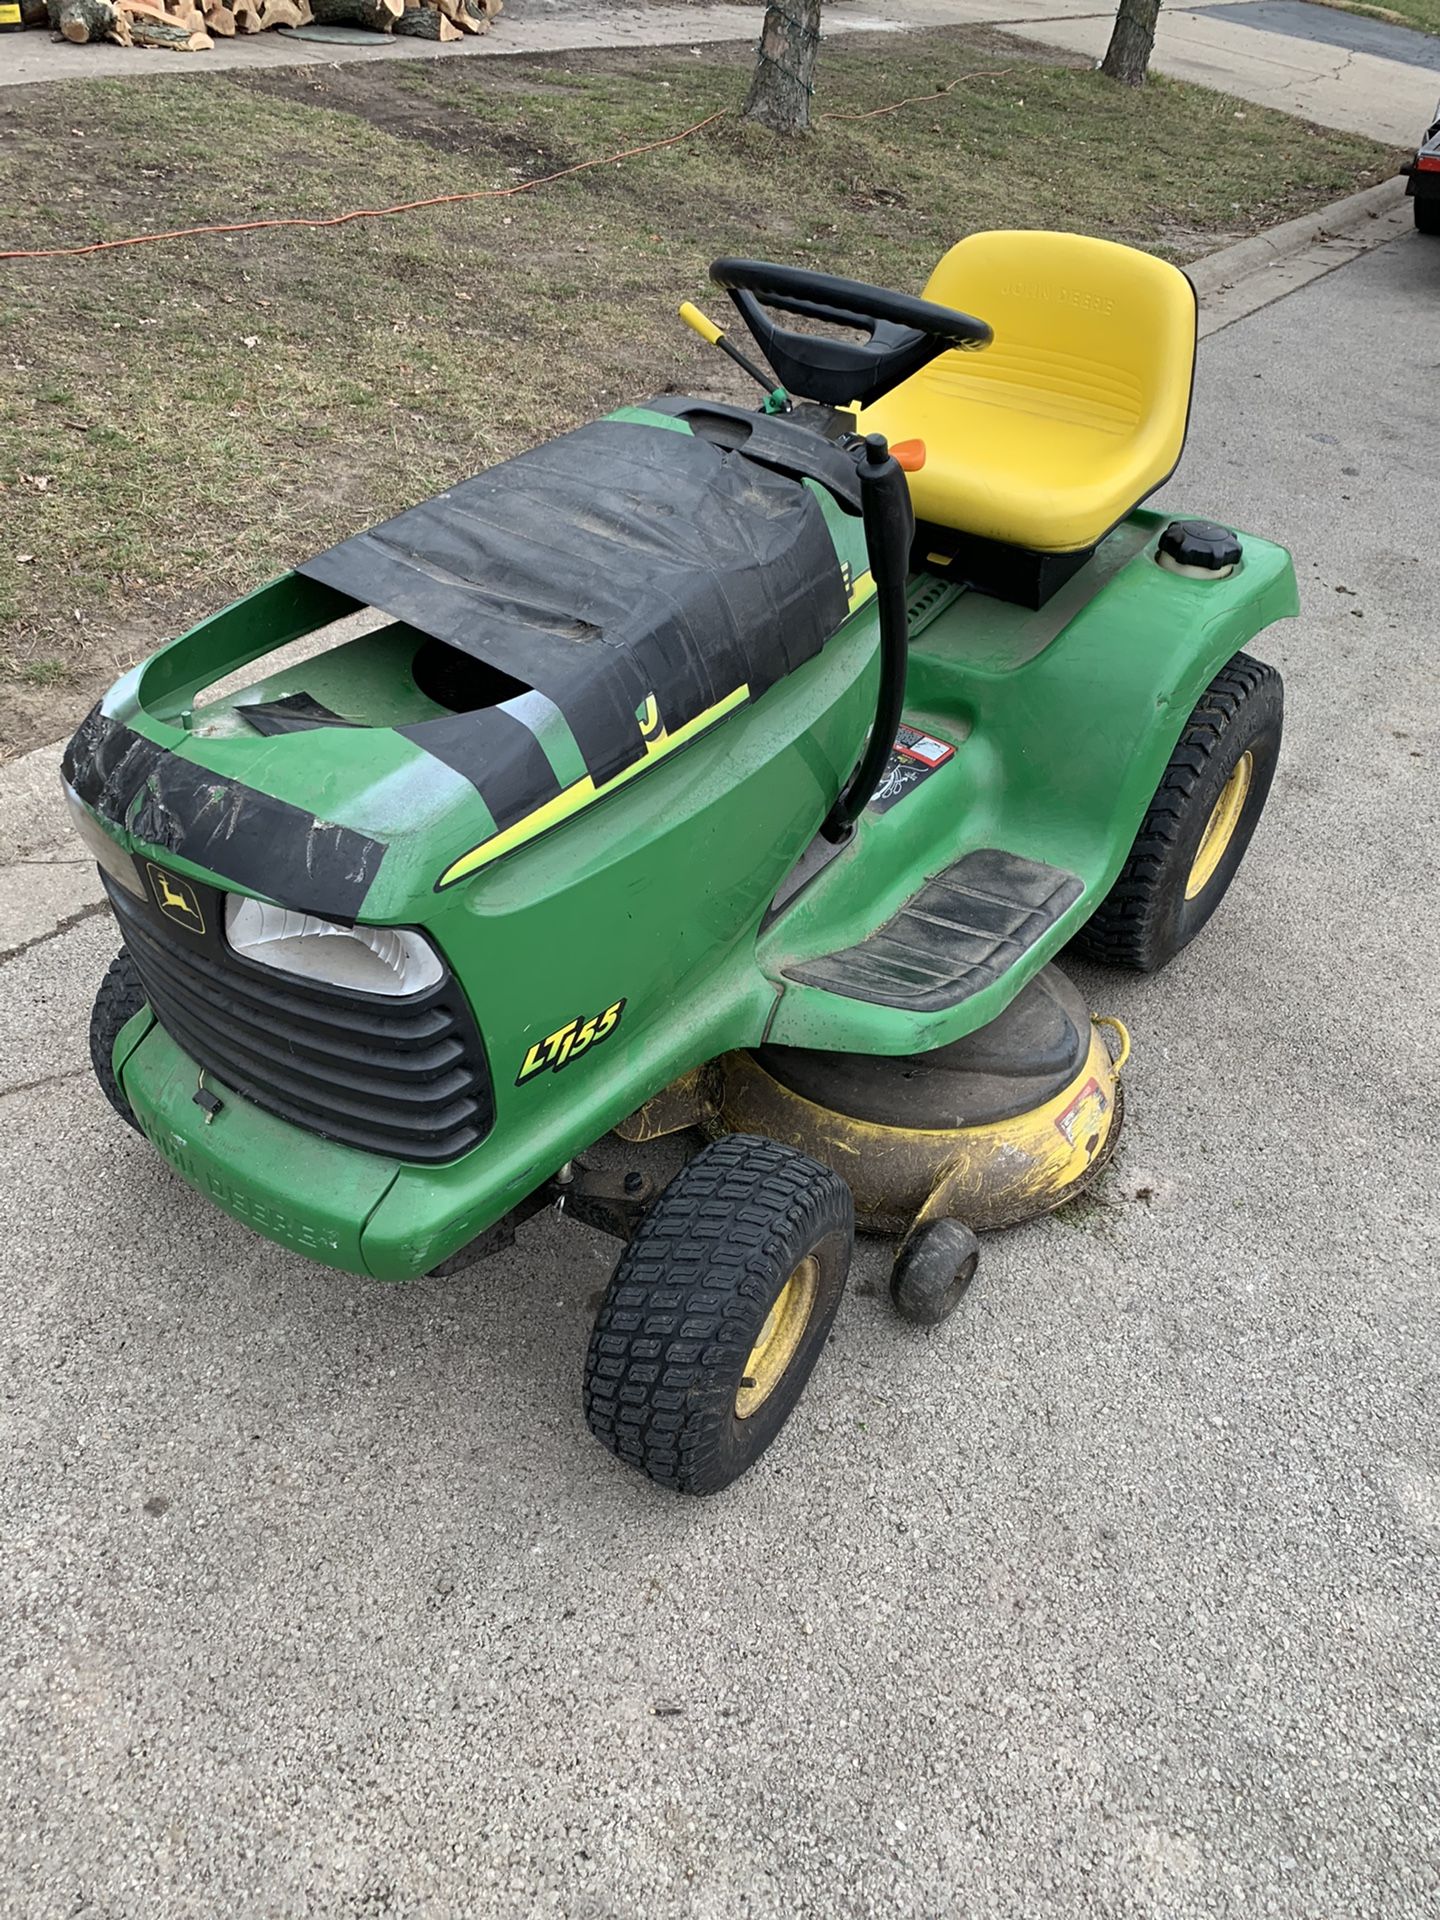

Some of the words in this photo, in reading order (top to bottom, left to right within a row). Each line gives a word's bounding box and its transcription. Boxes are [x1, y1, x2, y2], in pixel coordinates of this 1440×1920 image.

[1057, 287, 1116, 316] DEERE
[515, 998, 625, 1085] LT155
[206, 1172, 318, 1249] DEERE
